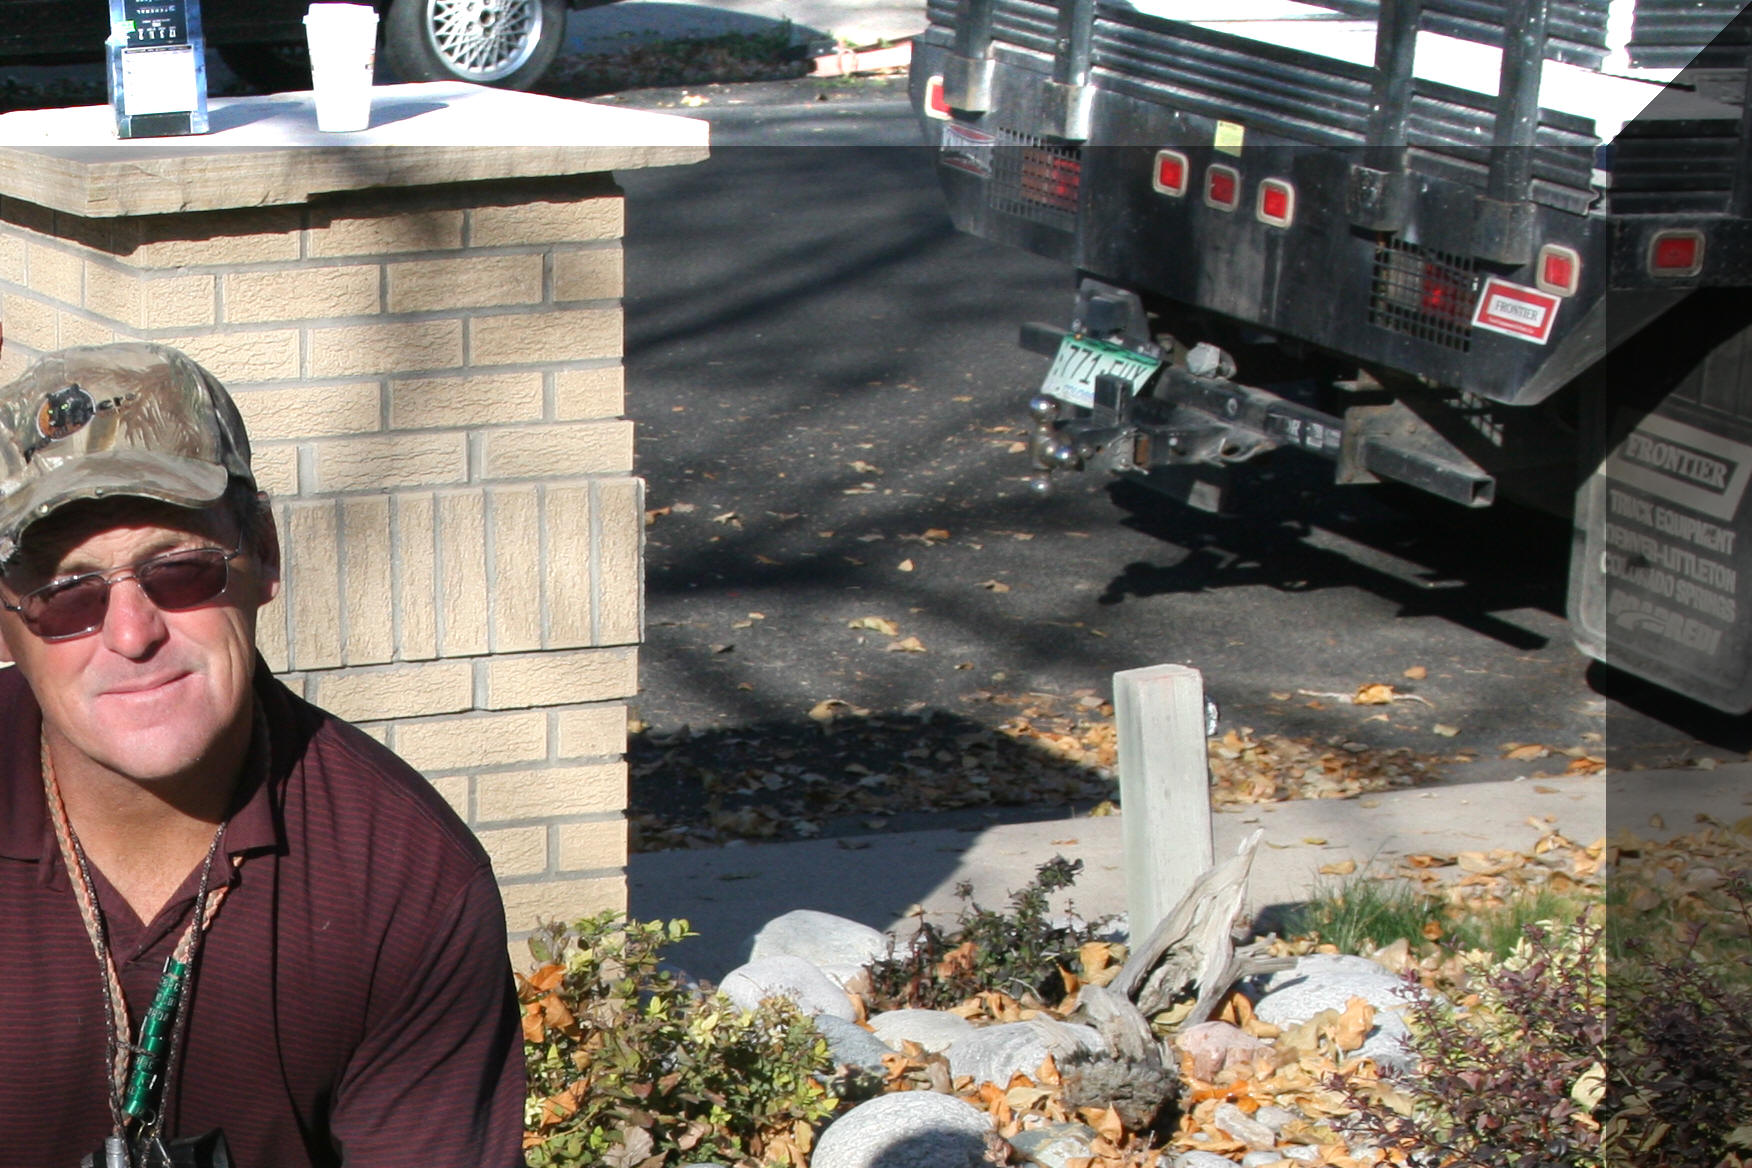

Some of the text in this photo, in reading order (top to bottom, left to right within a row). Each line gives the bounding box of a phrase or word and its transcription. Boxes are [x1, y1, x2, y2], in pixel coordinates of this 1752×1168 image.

[1625, 433, 1728, 489] FRONTIER
[1609, 488, 1737, 555] TRUCK EQUIPMENT
[1605, 522, 1737, 595] DENVER-LITTLETON
[1675, 576, 1736, 623] SPRINGS
